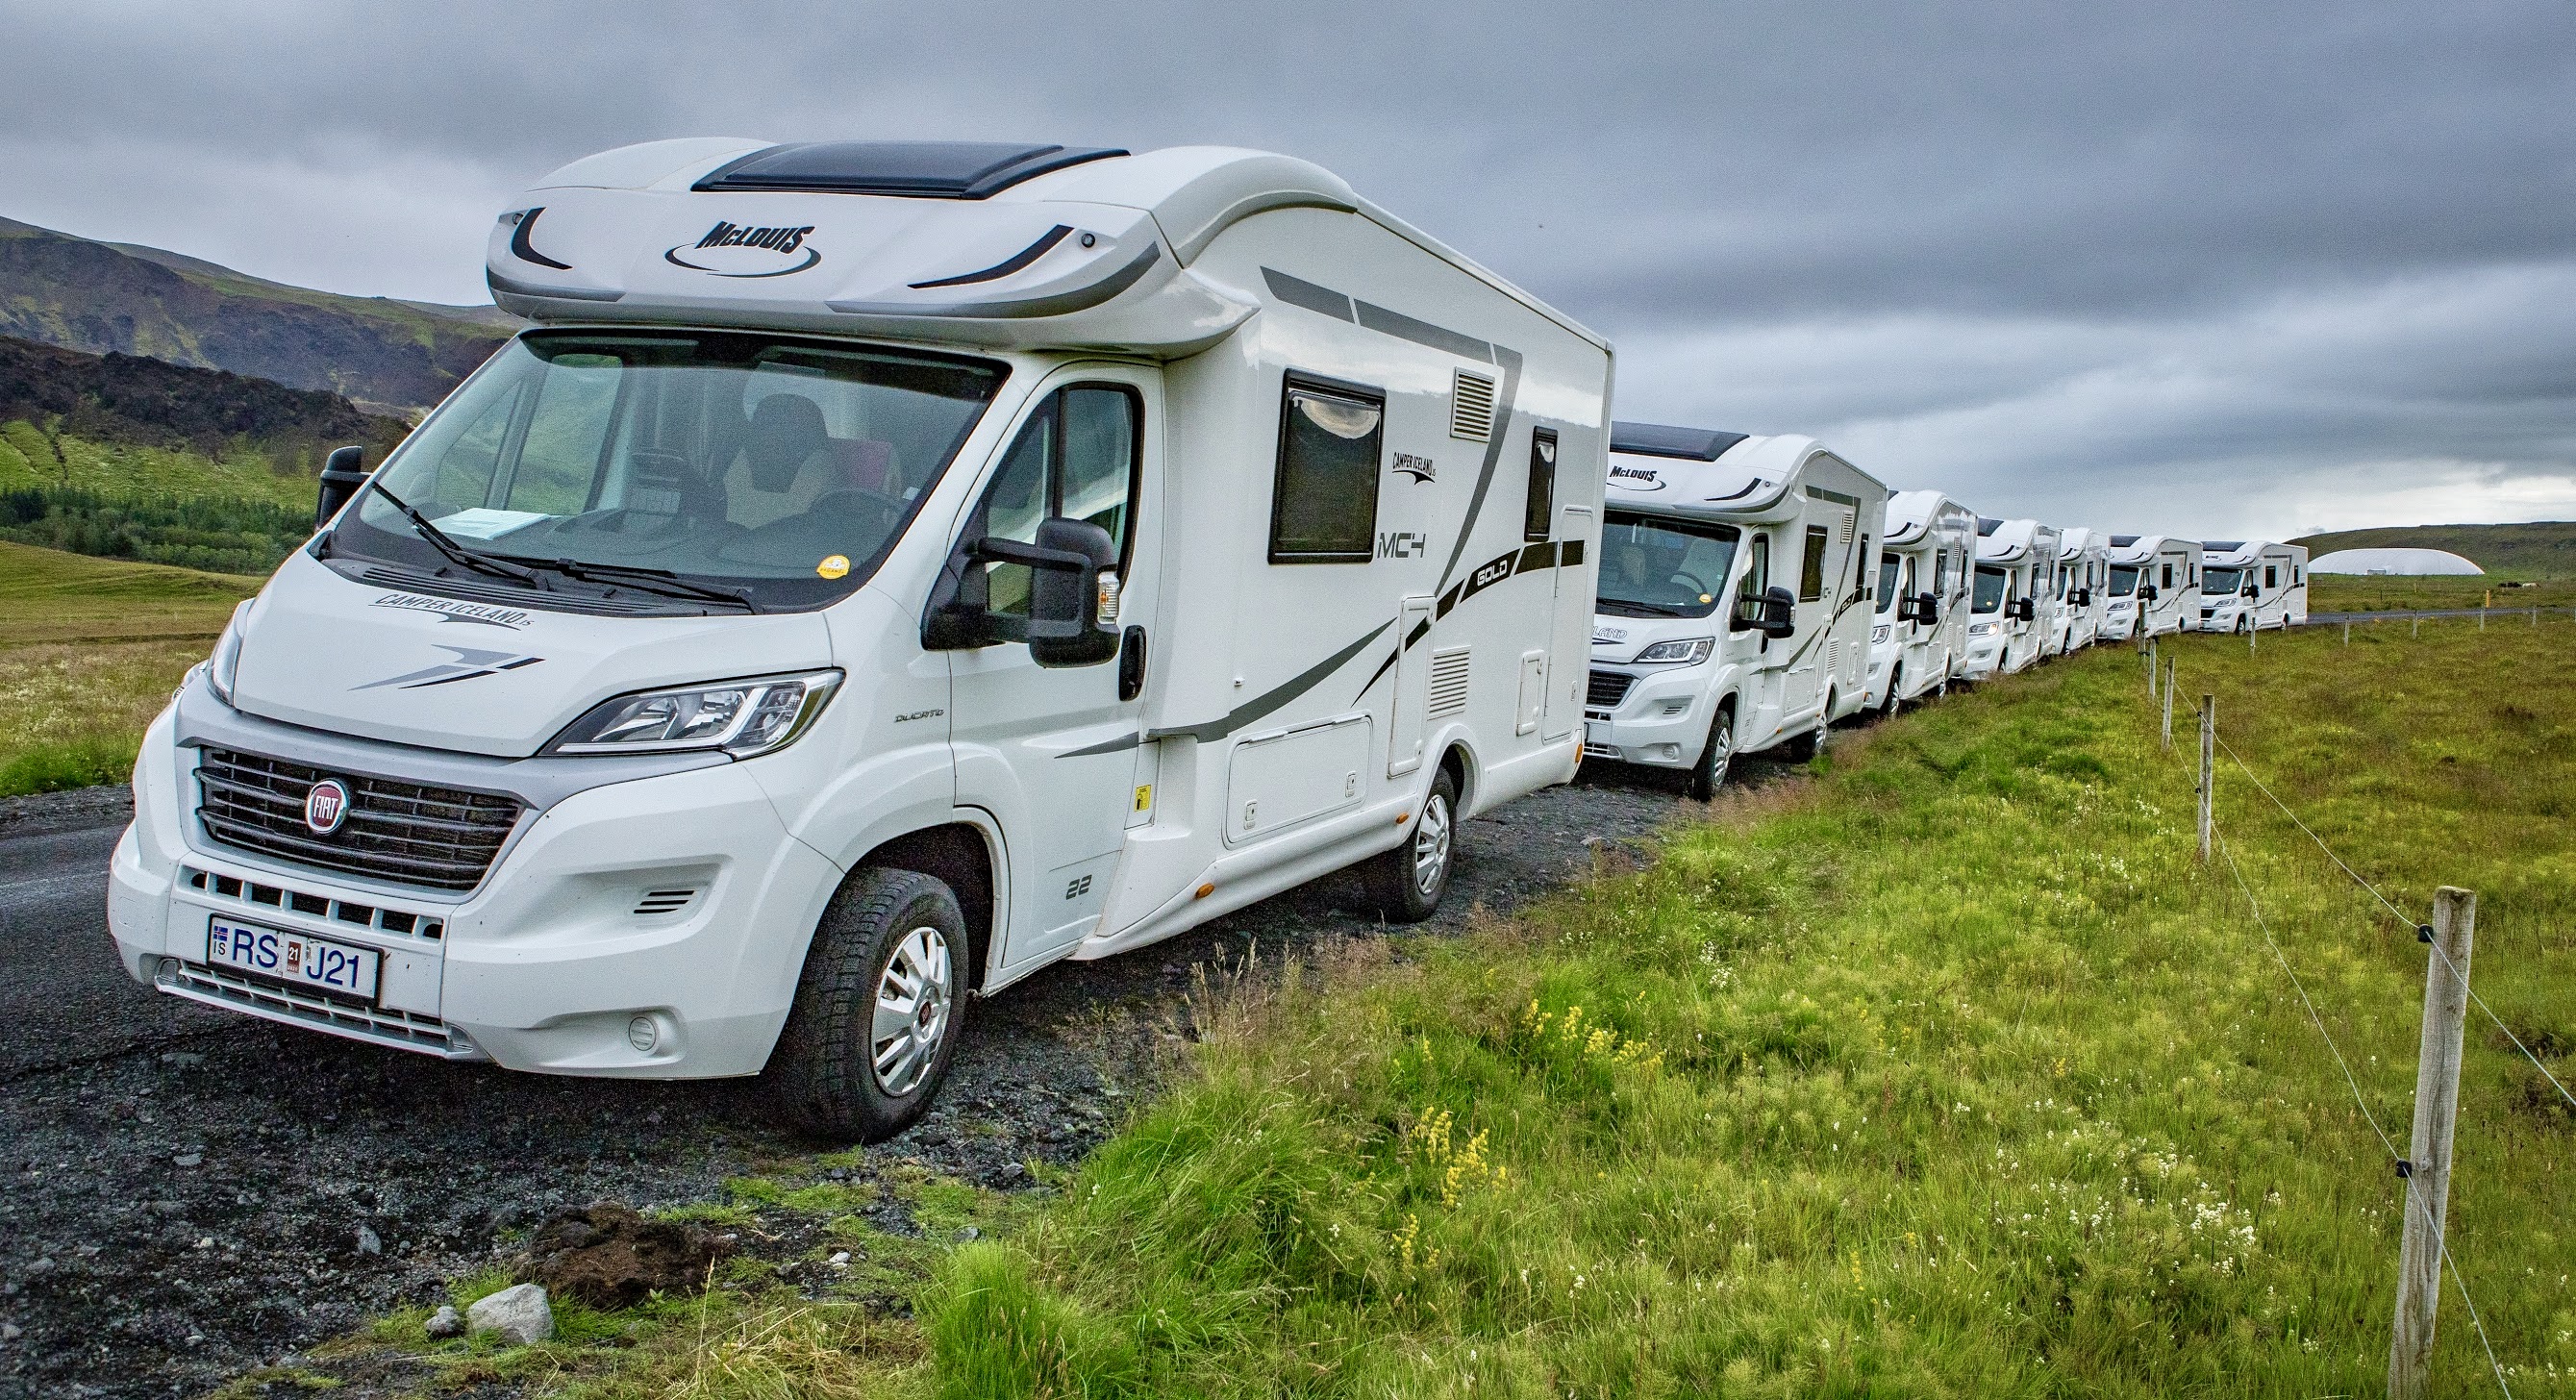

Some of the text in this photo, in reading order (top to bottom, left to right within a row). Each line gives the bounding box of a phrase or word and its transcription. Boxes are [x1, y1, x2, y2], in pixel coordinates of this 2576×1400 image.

[1392, 452, 1413, 469] CAMPER
[1476, 560, 1508, 587] GOLD
[375, 593, 453, 612] CAMPER
[313, 795, 339, 820] FIAT
[1065, 873, 1092, 900] 22
[213, 939, 226, 956] IS
[232, 928, 361, 988] RS J21
[288, 946, 299, 962] 21
